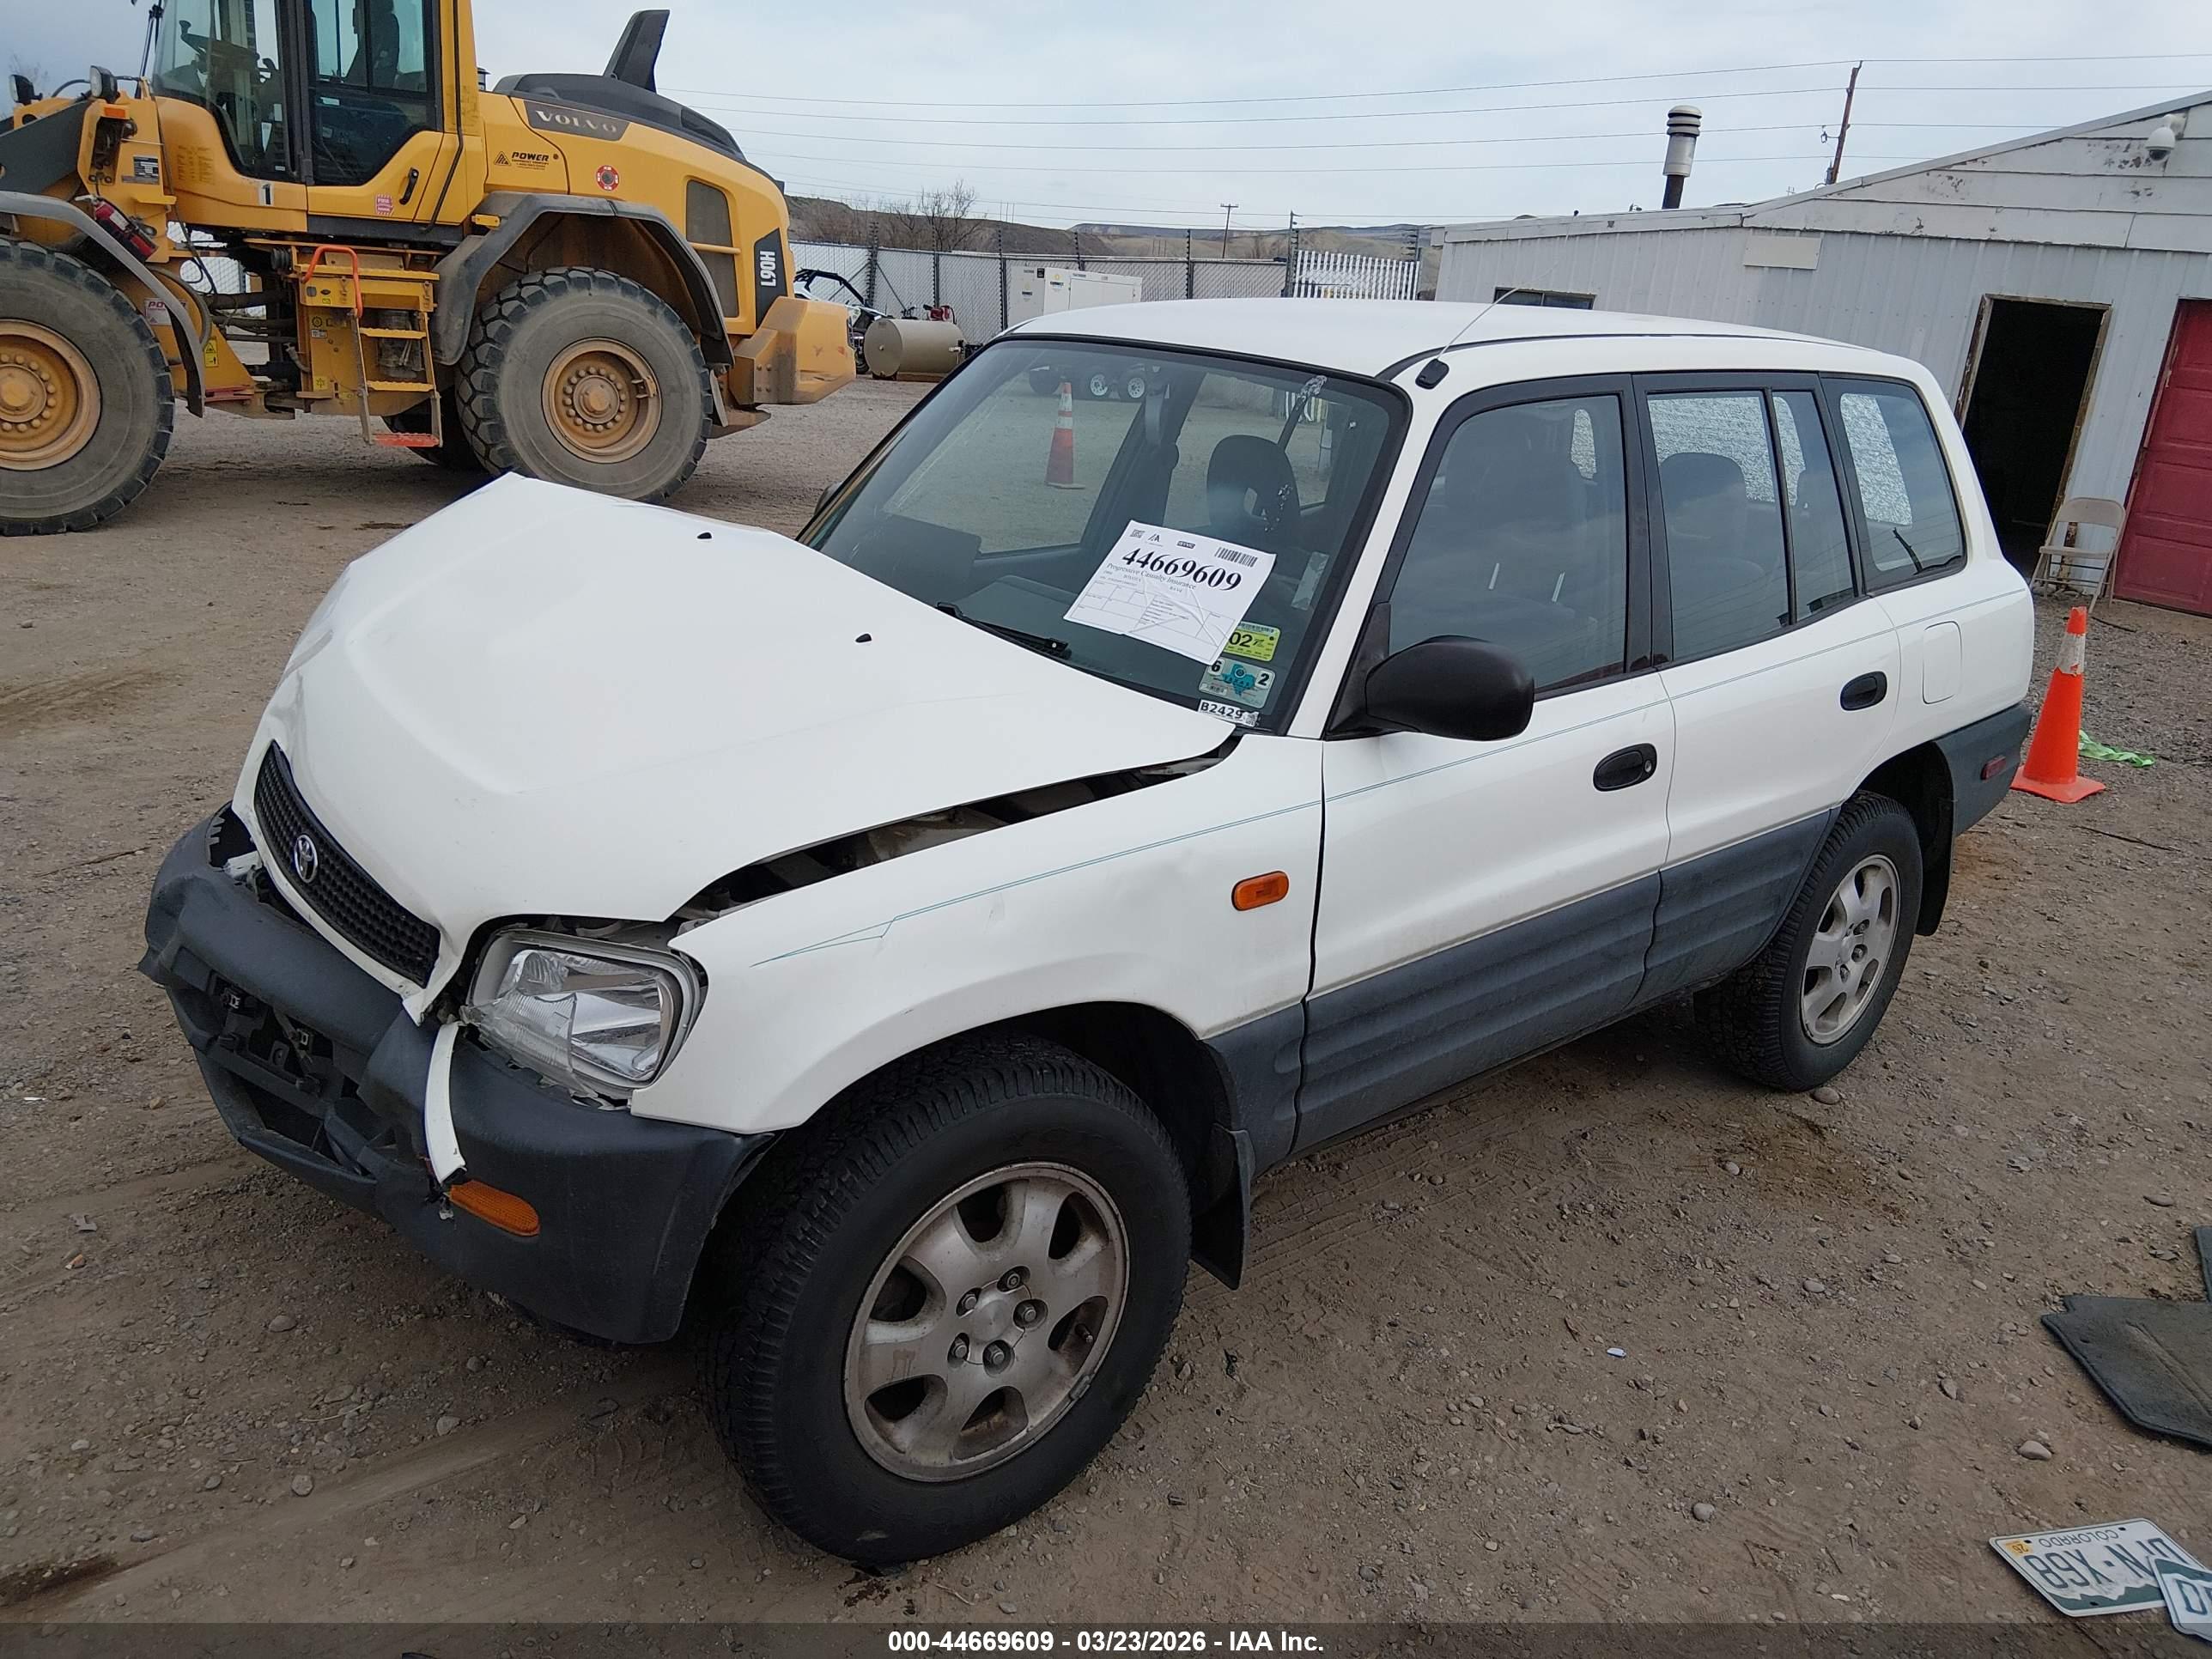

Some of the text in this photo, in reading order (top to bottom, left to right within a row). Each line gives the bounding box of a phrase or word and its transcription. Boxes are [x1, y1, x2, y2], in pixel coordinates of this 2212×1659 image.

[536, 110, 617, 132] VOLVO
[512, 151, 550, 162] POWER
[262, 184, 271, 205] 1
[759, 250, 777, 287] L90H
[1122, 548, 1242, 591] 44669609
[1140, 570, 1166, 582] Casualty
[1167, 576, 1196, 590] Insurance
[1229, 631, 1253, 647] 02
[1258, 673, 1269, 686] 2
[2039, 1529, 2119, 1548] COLORADO
[2013, 1543, 2029, 1554] 26
